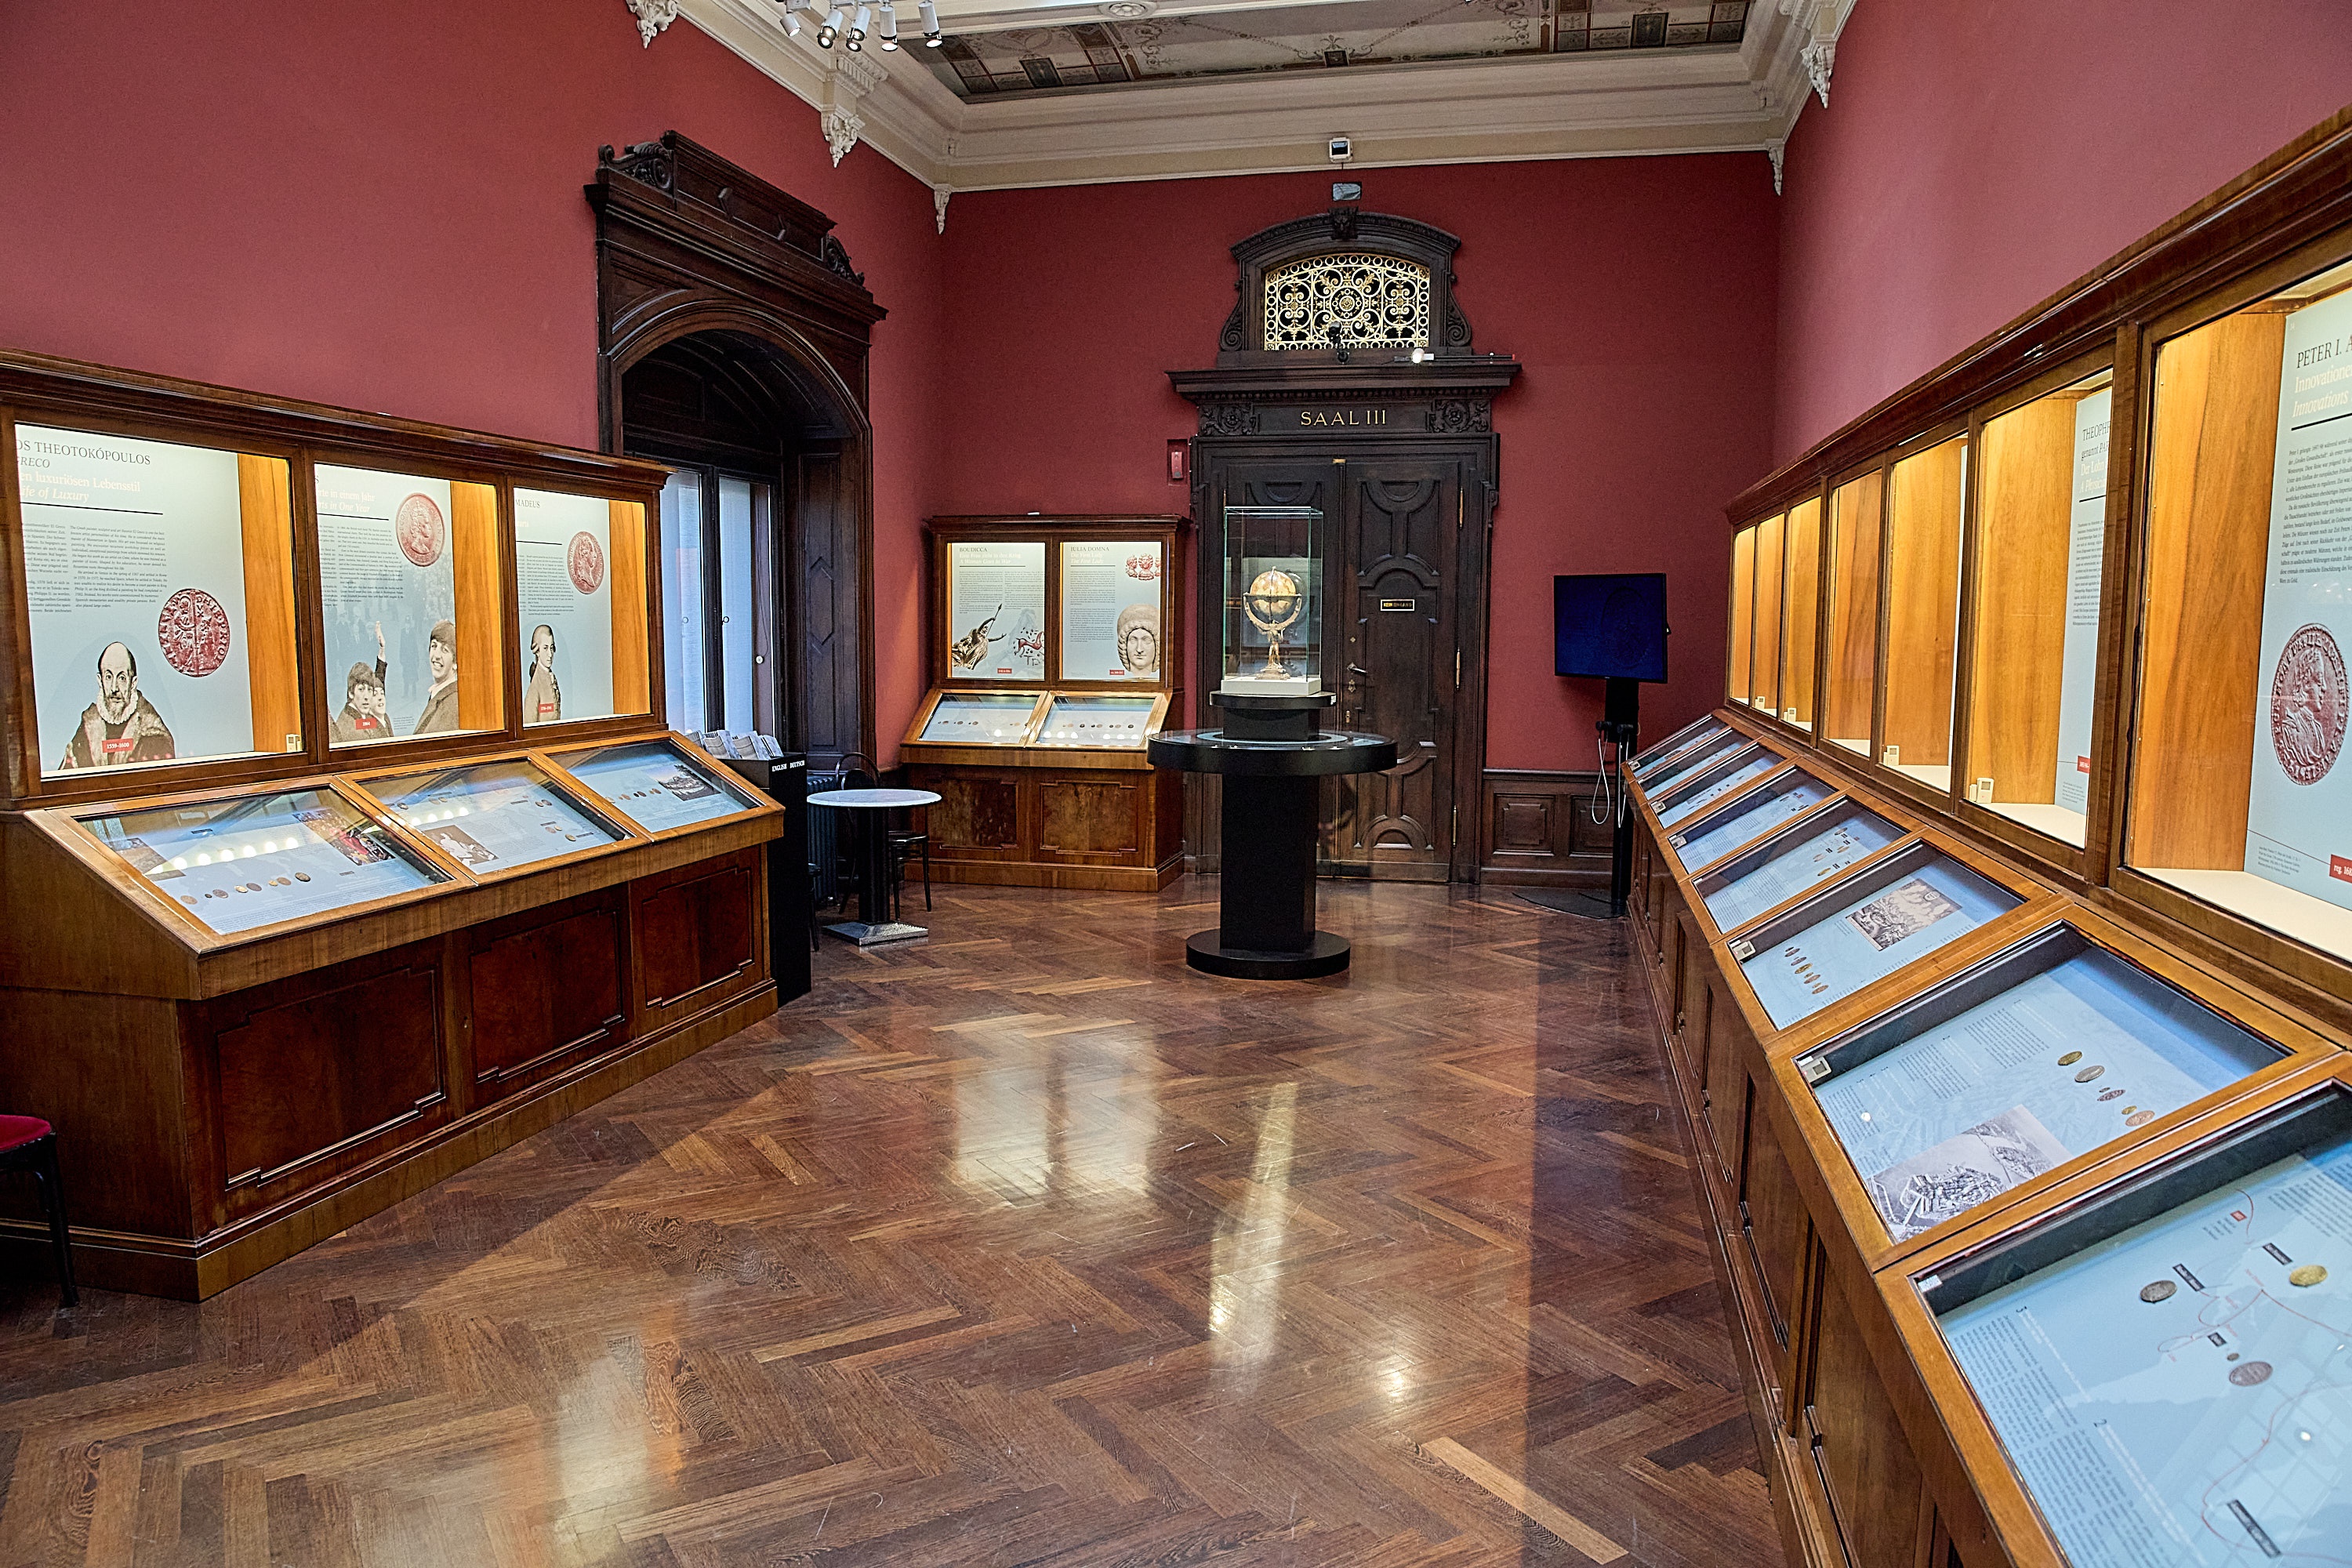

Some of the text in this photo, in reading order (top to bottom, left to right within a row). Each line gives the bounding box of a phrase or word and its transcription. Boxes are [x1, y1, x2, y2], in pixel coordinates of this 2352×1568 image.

[2296, 342, 2332, 368] PETER
[2335, 339, 2342, 356] I.
[2295, 365, 2352, 393] Innovatione
[2292, 390, 2349, 417] Innovations
[1301, 410, 1386, 426] SAAL III
[34, 441, 151, 465] THEOTOKÓPOULOS
[2081, 445, 2098, 461] genannt
[2091, 459, 2104, 473] Lohn
[36, 470, 89, 487] luxuriösen
[93, 477, 141, 492] Lebensstil
[20, 485, 89, 503] ife of Luxury
[339, 490, 360, 500] einem
[339, 502, 354, 511] One
[772, 760, 805, 772] ENGLISH DEUTSCH
[2334, 865, 2342, 875] reg.
